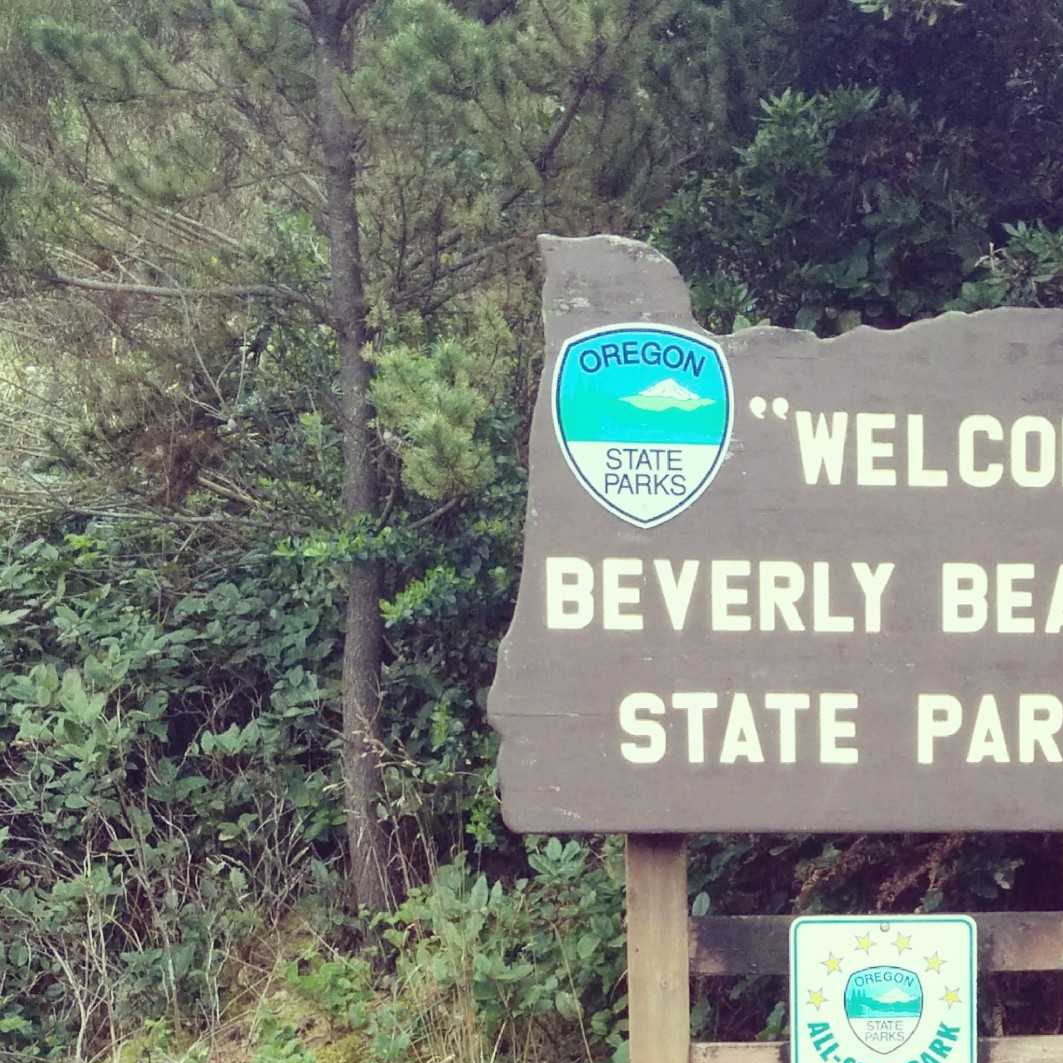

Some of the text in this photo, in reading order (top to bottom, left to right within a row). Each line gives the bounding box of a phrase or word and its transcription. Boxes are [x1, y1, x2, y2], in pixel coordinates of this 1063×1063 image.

[579, 341, 706, 377] OREGON
[605, 448, 683, 471] STATE
[604, 473, 687, 496] PARKS
[545, 557, 896, 634] BEVERLY
[618, 691, 859, 765] STATE
[854, 971, 914, 988] OREGON
[864, 1031, 905, 1042] PARKS
[866, 1020, 903, 1031] STATE
